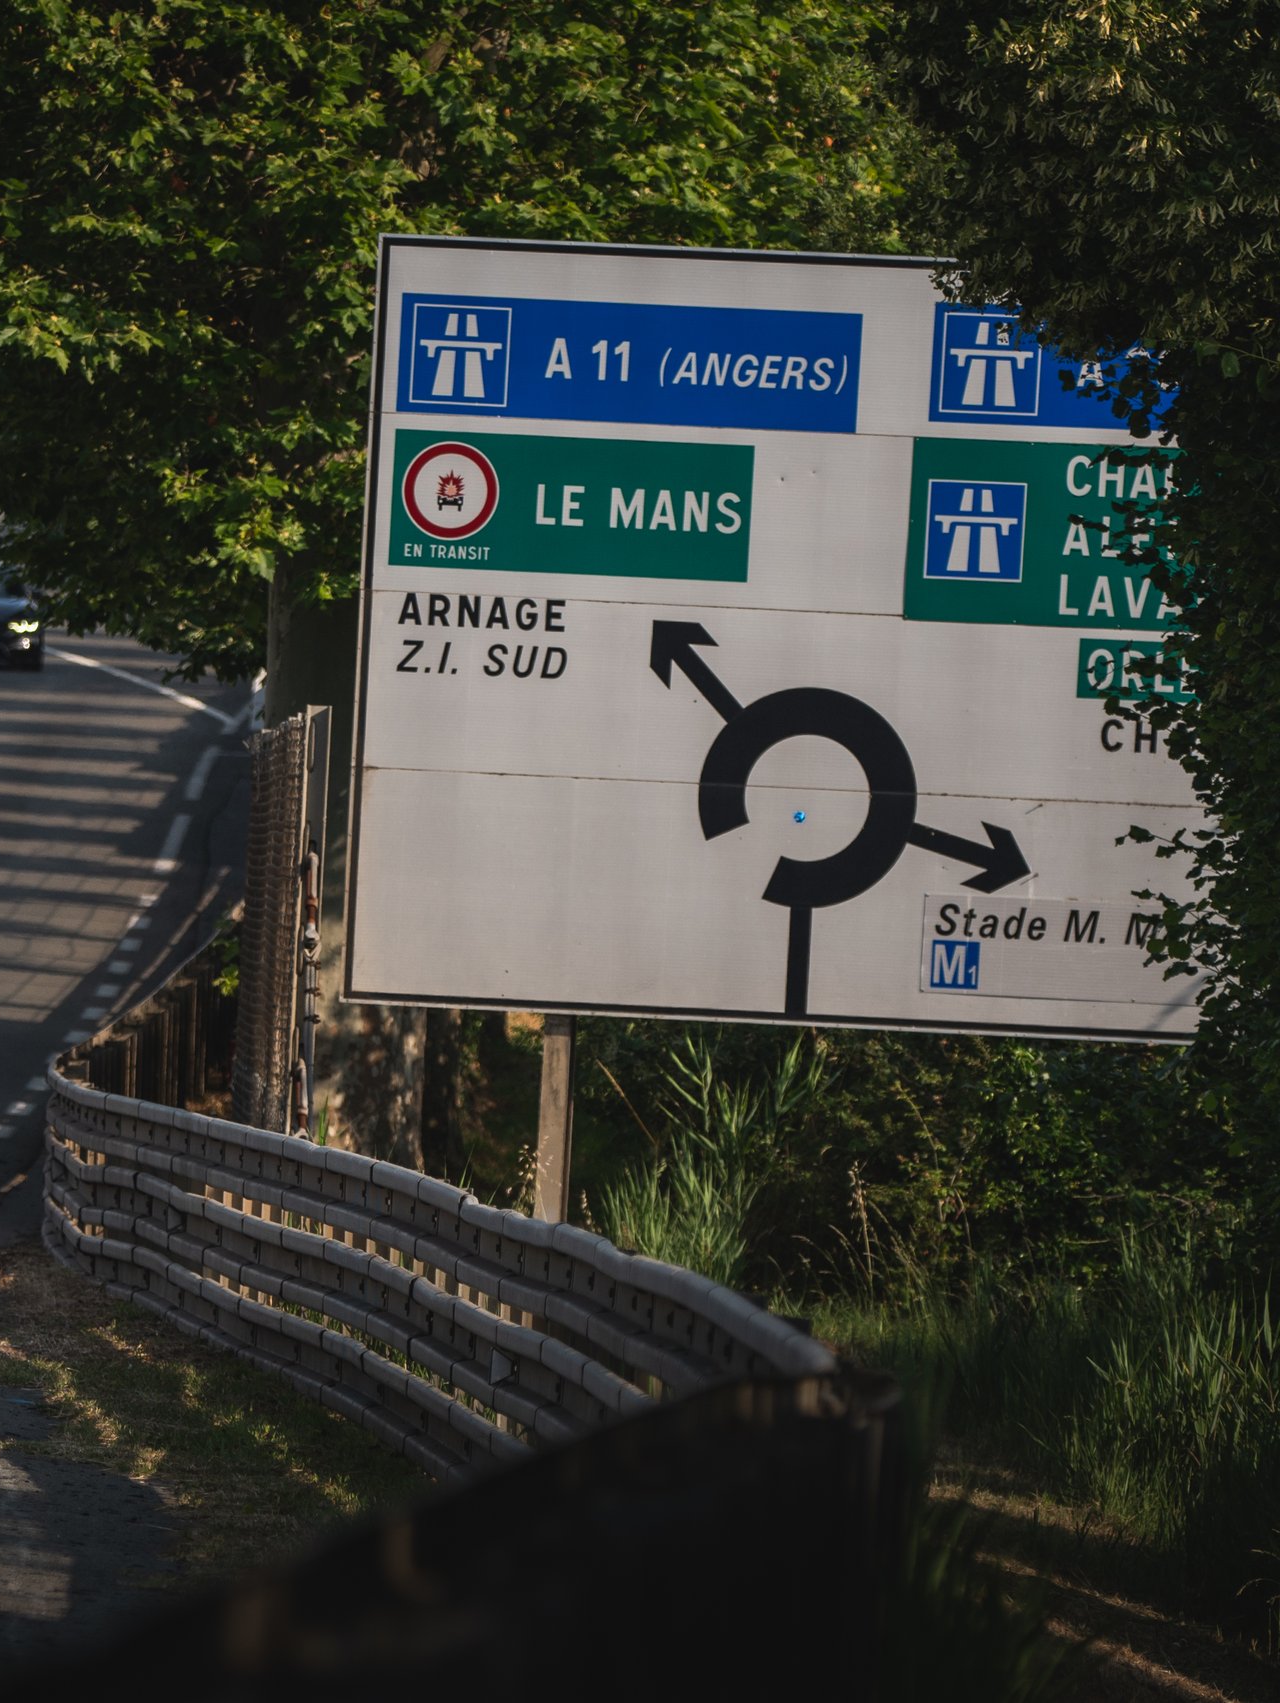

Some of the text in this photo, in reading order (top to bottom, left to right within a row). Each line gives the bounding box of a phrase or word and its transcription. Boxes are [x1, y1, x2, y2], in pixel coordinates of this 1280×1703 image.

[545, 338, 848, 395] A 11 (ANGERS)
[535, 483, 742, 535] LE MANS
[403, 543, 491, 561] EN TRANSIT
[1062, 515, 1178, 560] ALE
[398, 592, 567, 633] ARNAGE
[1058, 573, 1184, 620] LAVA
[396, 639, 568, 680] Z.I. SUD
[1087, 648, 1198, 694] ORLE
[1101, 719, 1158, 754] CH
[934, 903, 1047, 941] Stade
[1063, 909, 1106, 945] M.
